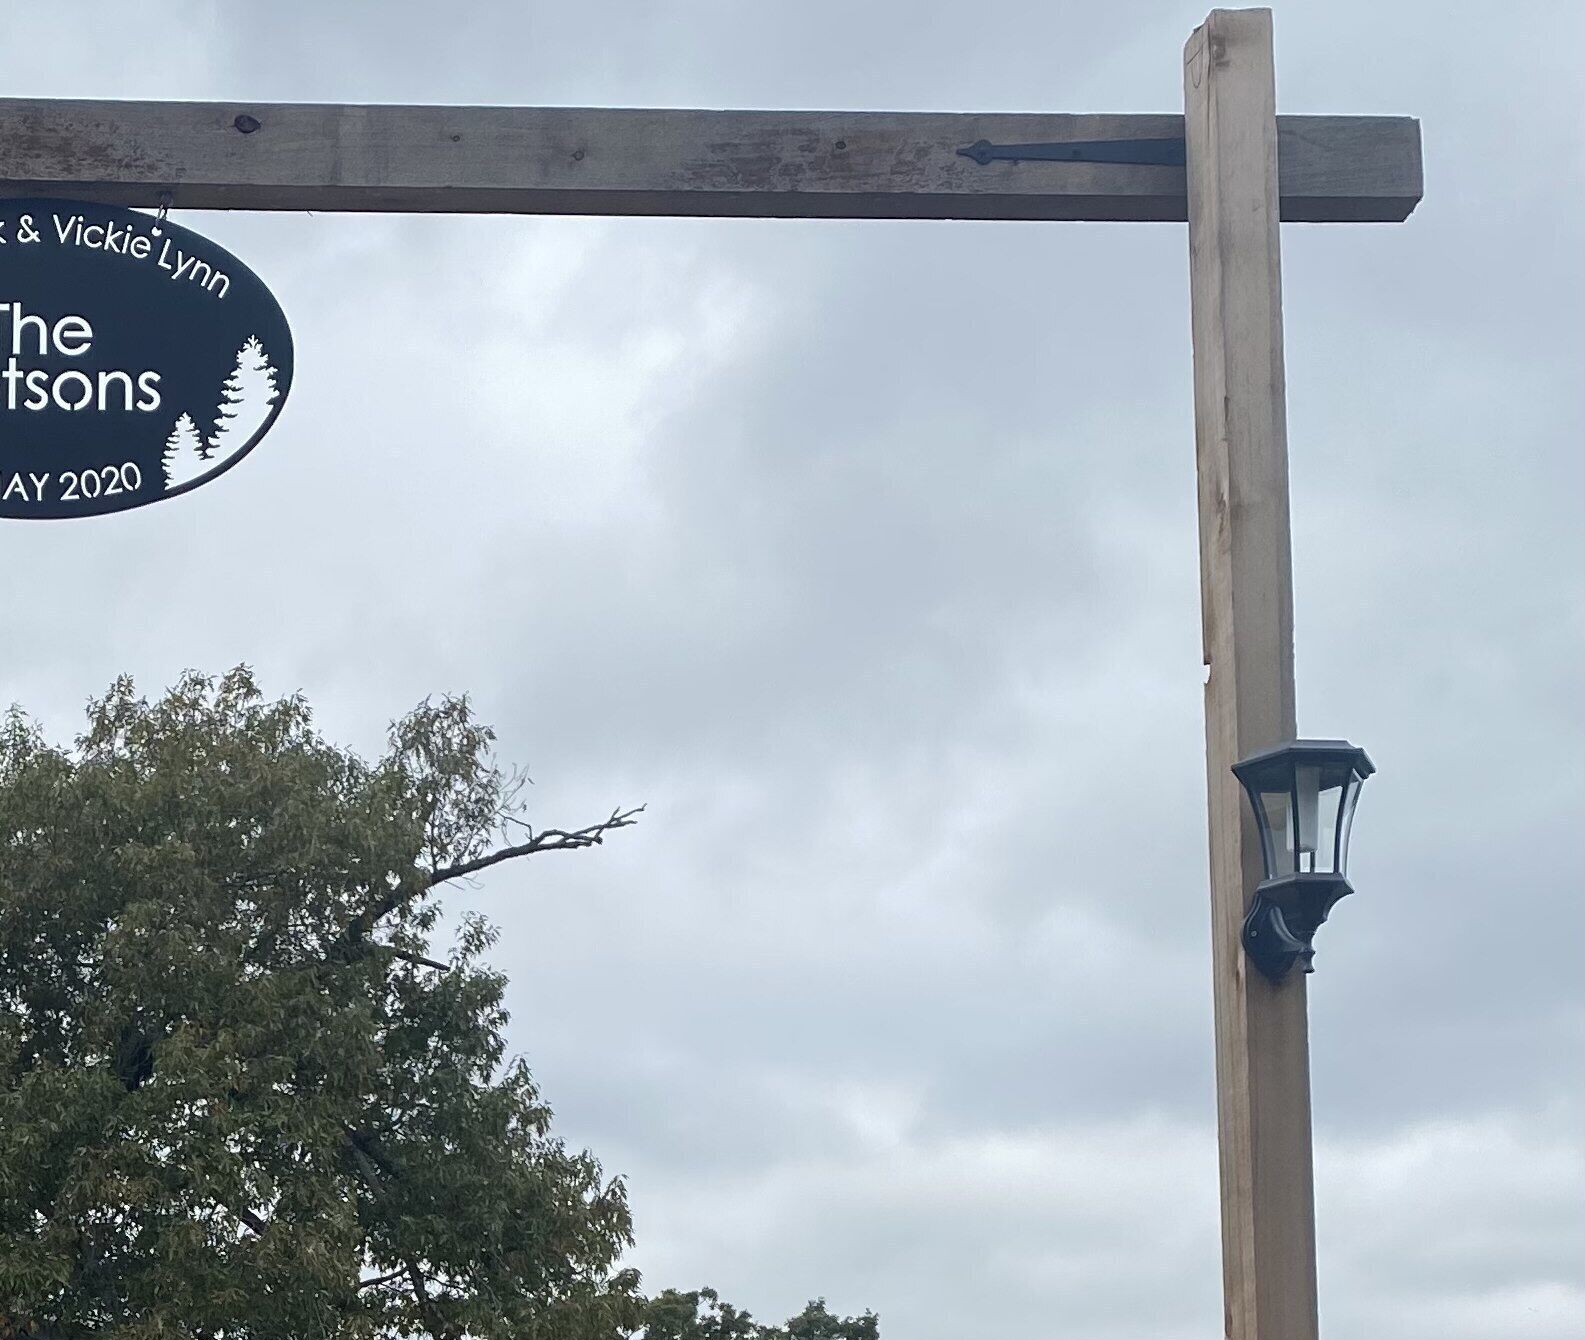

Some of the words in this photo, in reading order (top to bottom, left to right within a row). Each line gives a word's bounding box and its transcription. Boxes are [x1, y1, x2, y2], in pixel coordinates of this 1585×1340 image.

[16, 214, 42, 244] &
[52, 213, 152, 260] Vickie
[156, 237, 231, 300] Lynn
[58, 461, 143, 502] 2020
